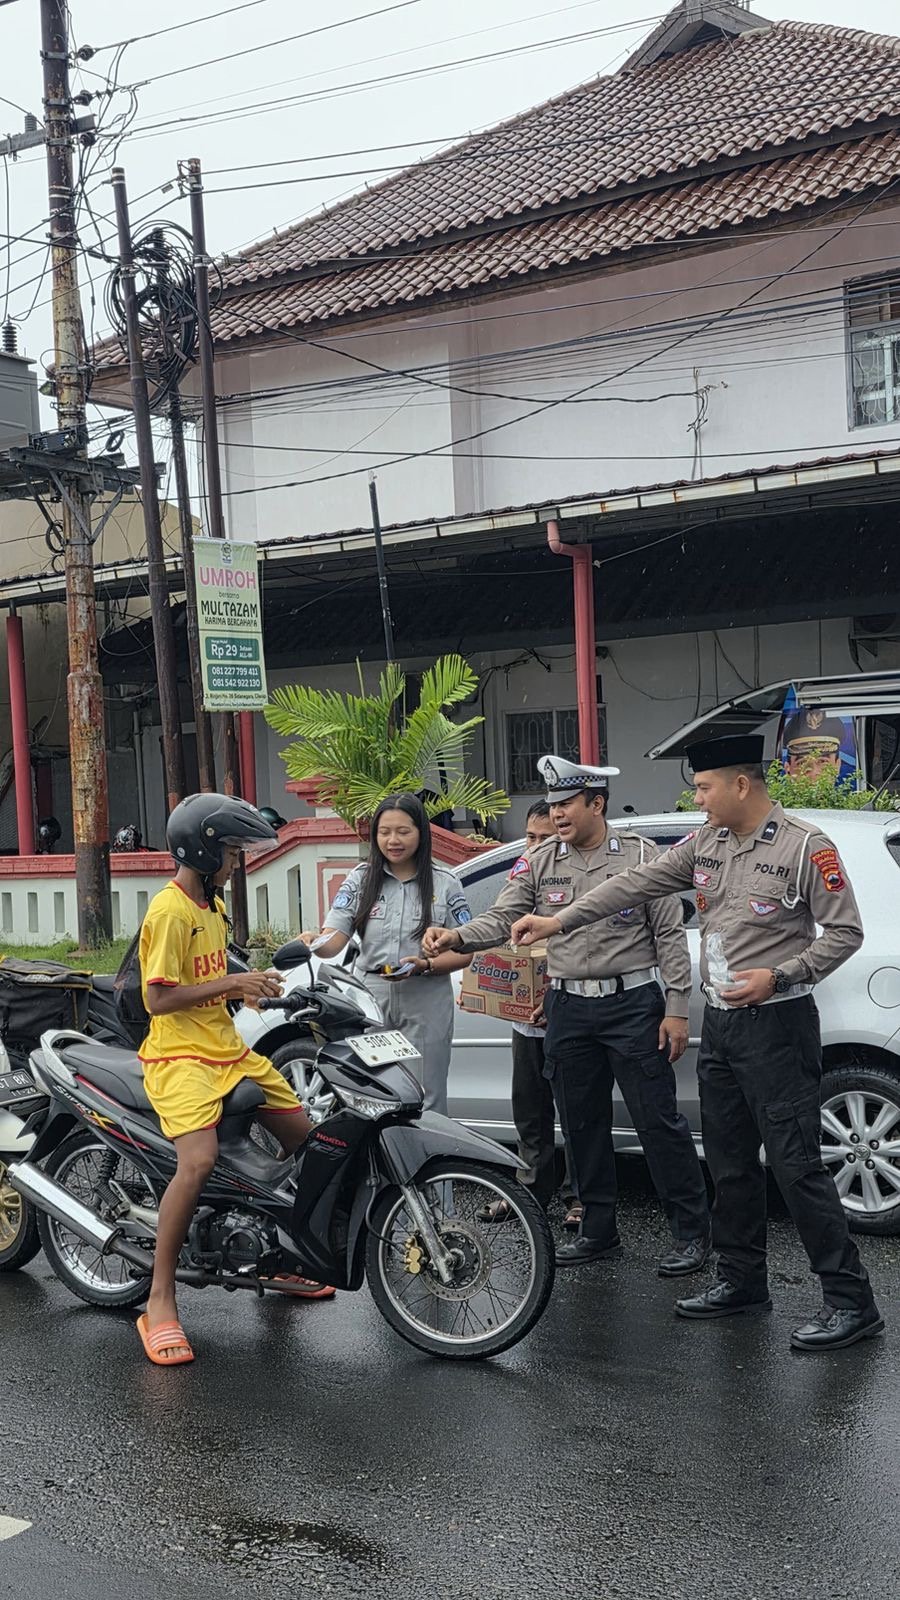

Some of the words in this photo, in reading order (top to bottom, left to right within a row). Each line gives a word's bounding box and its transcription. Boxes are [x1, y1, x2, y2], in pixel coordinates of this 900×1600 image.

[200, 566, 256, 590] UMROH
[219, 591, 240, 599] bersama
[200, 600, 258, 618] MULTAZAM
[211, 644, 224, 659] Rp
[225, 645, 238, 657] 29
[212, 666, 224, 675] 081
[224, 667, 235, 675] 227
[236, 667, 248, 676] 799
[248, 667, 258, 676] 411
[212, 678, 224, 687] 081
[225, 678, 237, 687] 542
[237, 679, 249, 687] 922
[249, 679, 260, 687] 130
[753, 862, 791, 878] POLRI
[514, 959, 528, 968] 20
[470, 961, 520, 982] Sedaap
[504, 1005, 532, 1017] GORENG
[350, 1039, 364, 1051] R
[363, 1034, 392, 1048] 5080
[316, 1132, 348, 1147] HONDA
